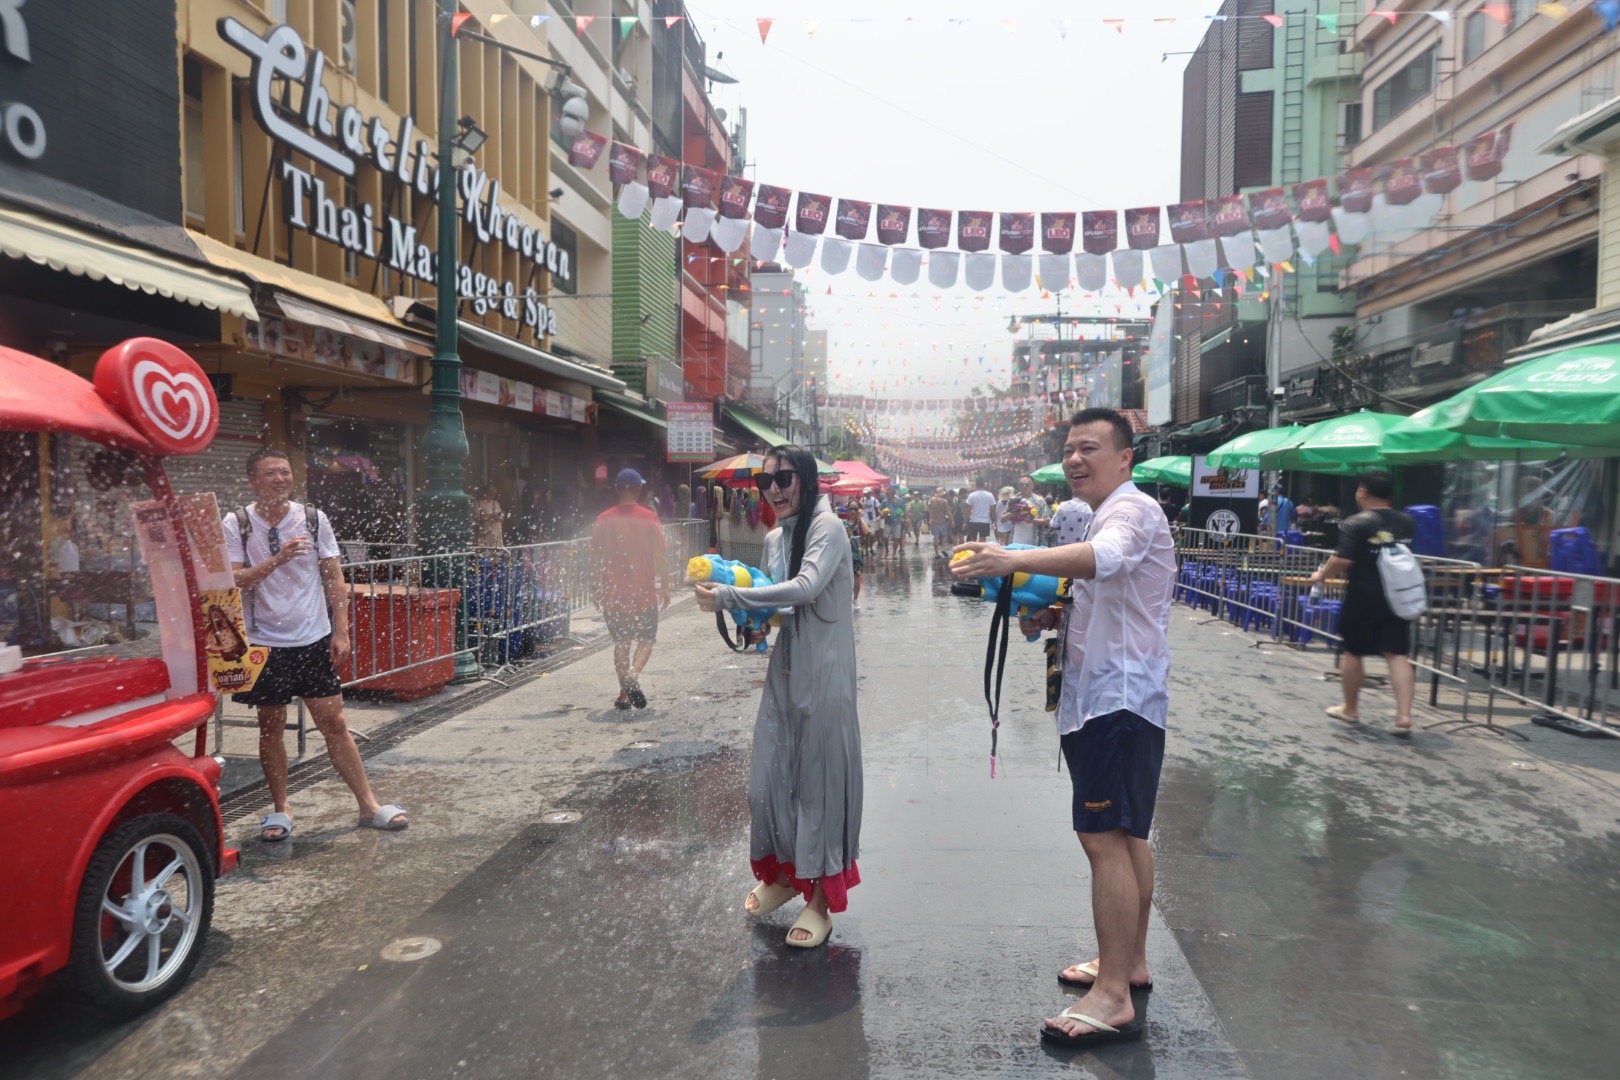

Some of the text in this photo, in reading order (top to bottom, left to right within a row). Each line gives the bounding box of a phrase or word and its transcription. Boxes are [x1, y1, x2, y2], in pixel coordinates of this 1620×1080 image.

[650, 172, 670, 185] LEO
[723, 191, 745, 206] LEO
[802, 208, 823, 221] LEO
[1217, 211, 1241, 224] LEO
[462, 162, 571, 281] Khaosan
[881, 220, 903, 231] LEO
[963, 226, 986, 237] LEO
[1048, 228, 1070, 239] LEO
[1132, 224, 1155, 235] LEO
[282, 162, 558, 341] Thai Maage & Spa
[1528, 370, 1618, 384] Chang
[1322, 433, 1371, 441] Chang
